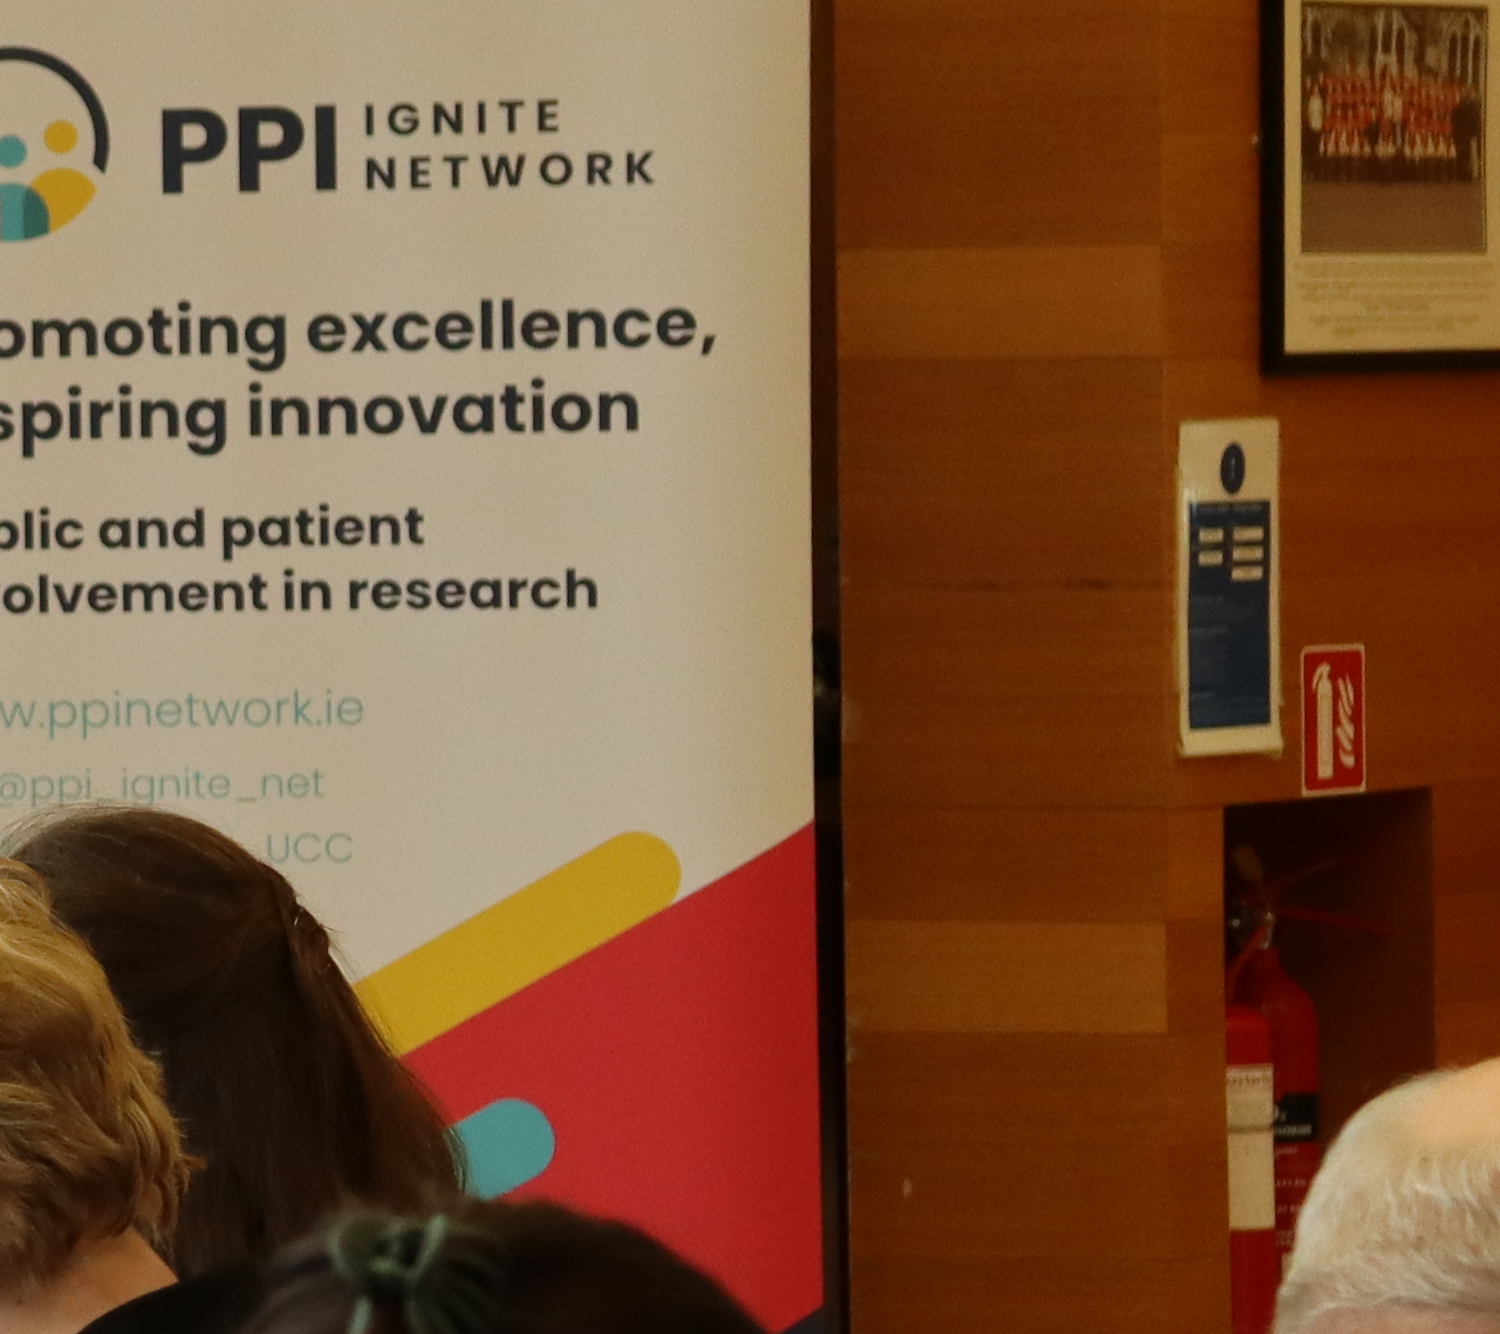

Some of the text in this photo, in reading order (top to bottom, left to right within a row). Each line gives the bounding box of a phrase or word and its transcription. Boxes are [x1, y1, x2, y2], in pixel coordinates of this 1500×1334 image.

[364, 99, 561, 138] IGNITE
[161, 105, 338, 195] PPI
[365, 149, 657, 191] NETWORK
[306, 297, 717, 357] excellence,
[248, 378, 641, 440] innovation
[98, 504, 207, 551] and
[221, 503, 426, 560] patient
[283, 568, 333, 612] in
[348, 567, 599, 612] research
[266, 833, 354, 864] UCC
